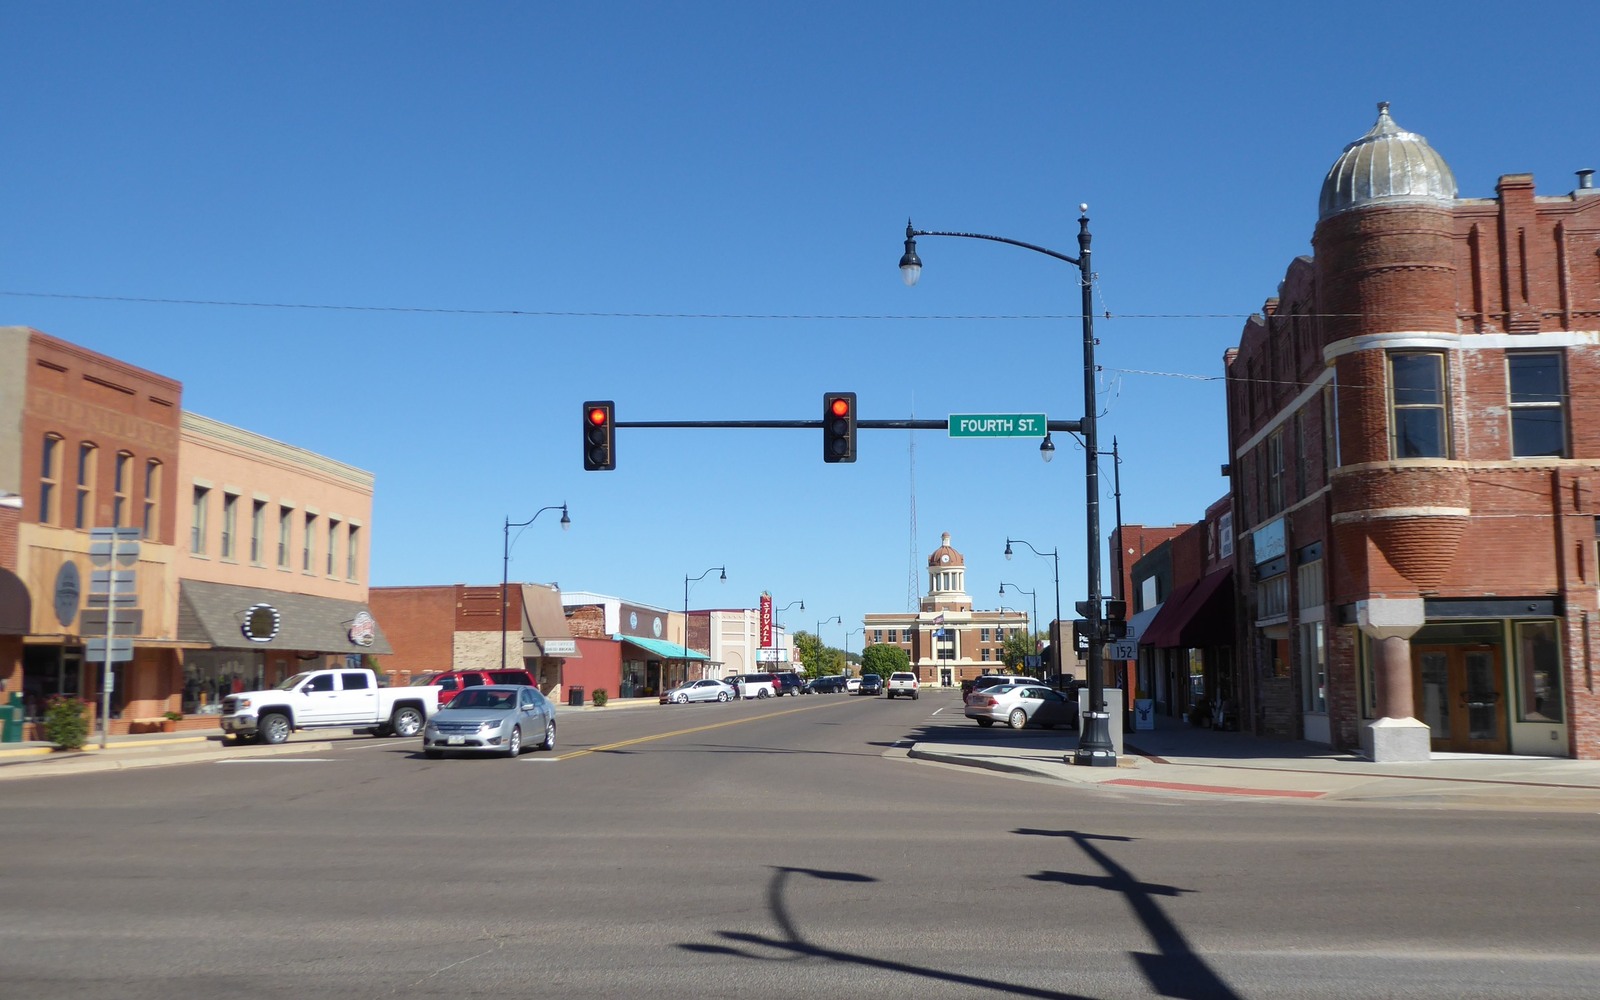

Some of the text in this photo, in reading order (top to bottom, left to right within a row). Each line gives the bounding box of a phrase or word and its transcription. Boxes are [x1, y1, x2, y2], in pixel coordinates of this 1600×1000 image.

[960, 418, 1038, 432] FOURTH ST.
[763, 602, 771, 642] STOVALL
[1116, 646, 1132, 658] 152
